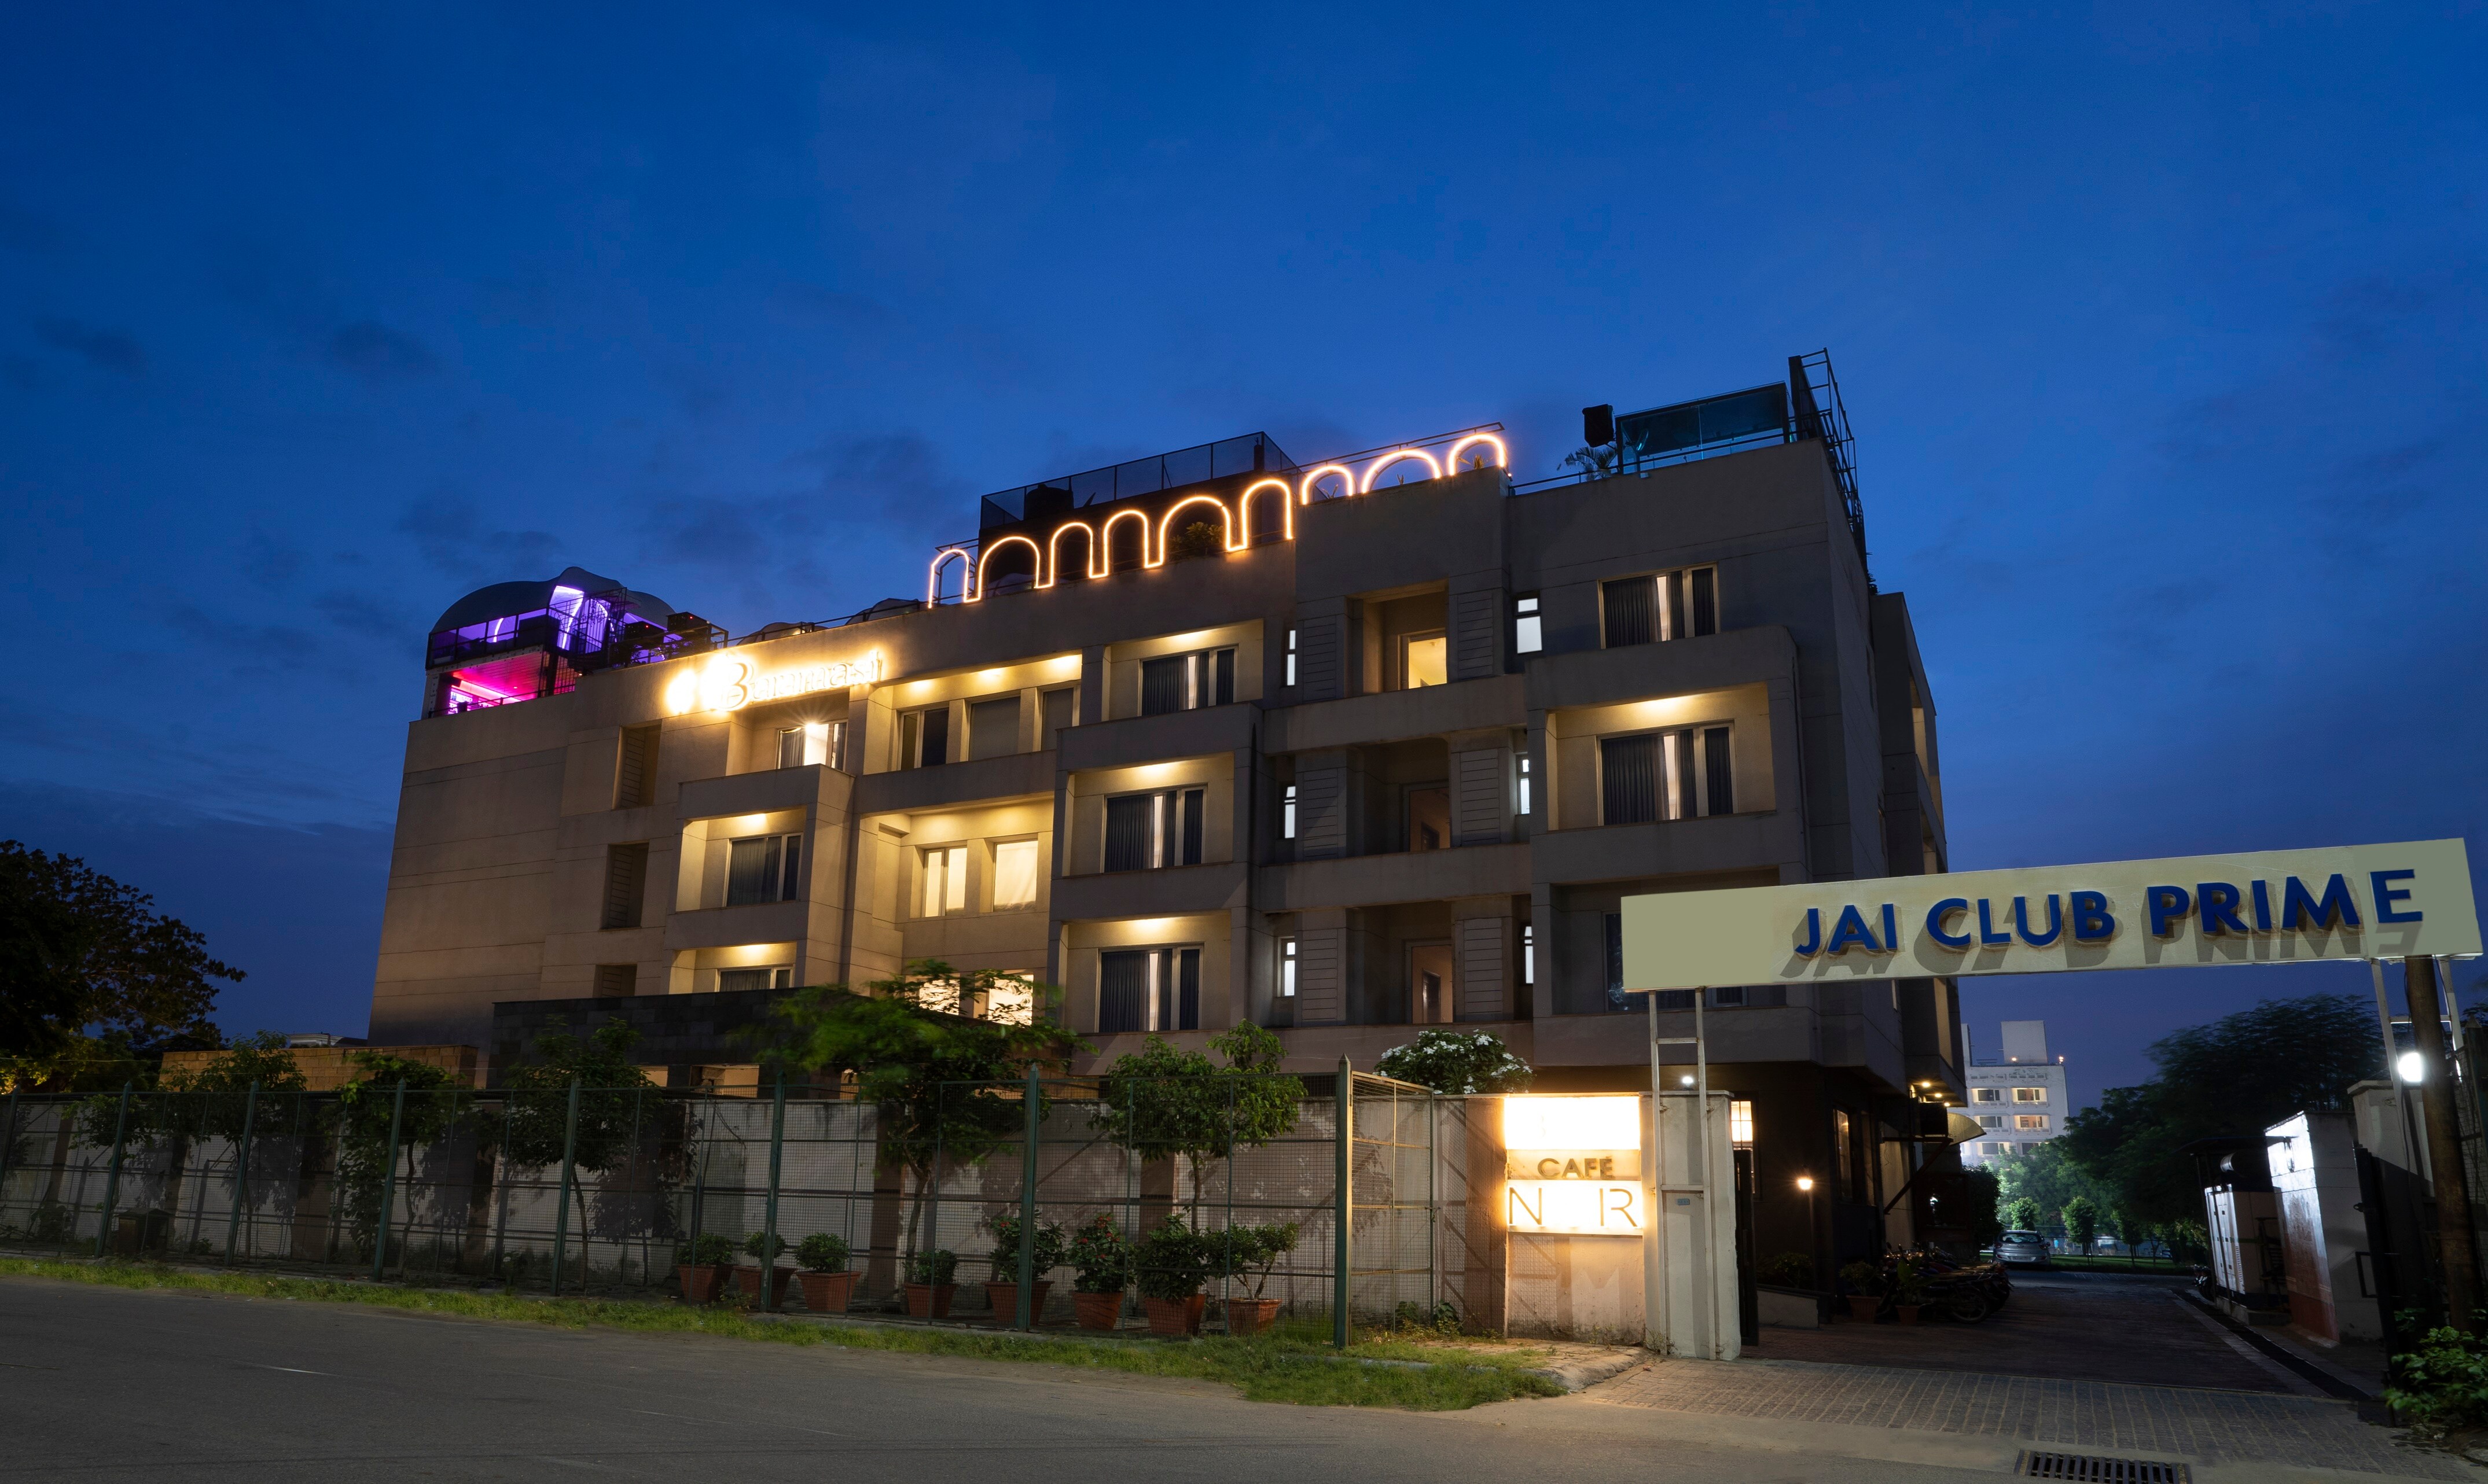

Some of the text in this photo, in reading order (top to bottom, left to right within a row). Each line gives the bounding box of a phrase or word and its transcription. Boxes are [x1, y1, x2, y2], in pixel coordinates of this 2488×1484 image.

[1795, 869, 2423, 954] JAI CLUB PRIME
[1509, 1187, 1638, 1227] NIR
